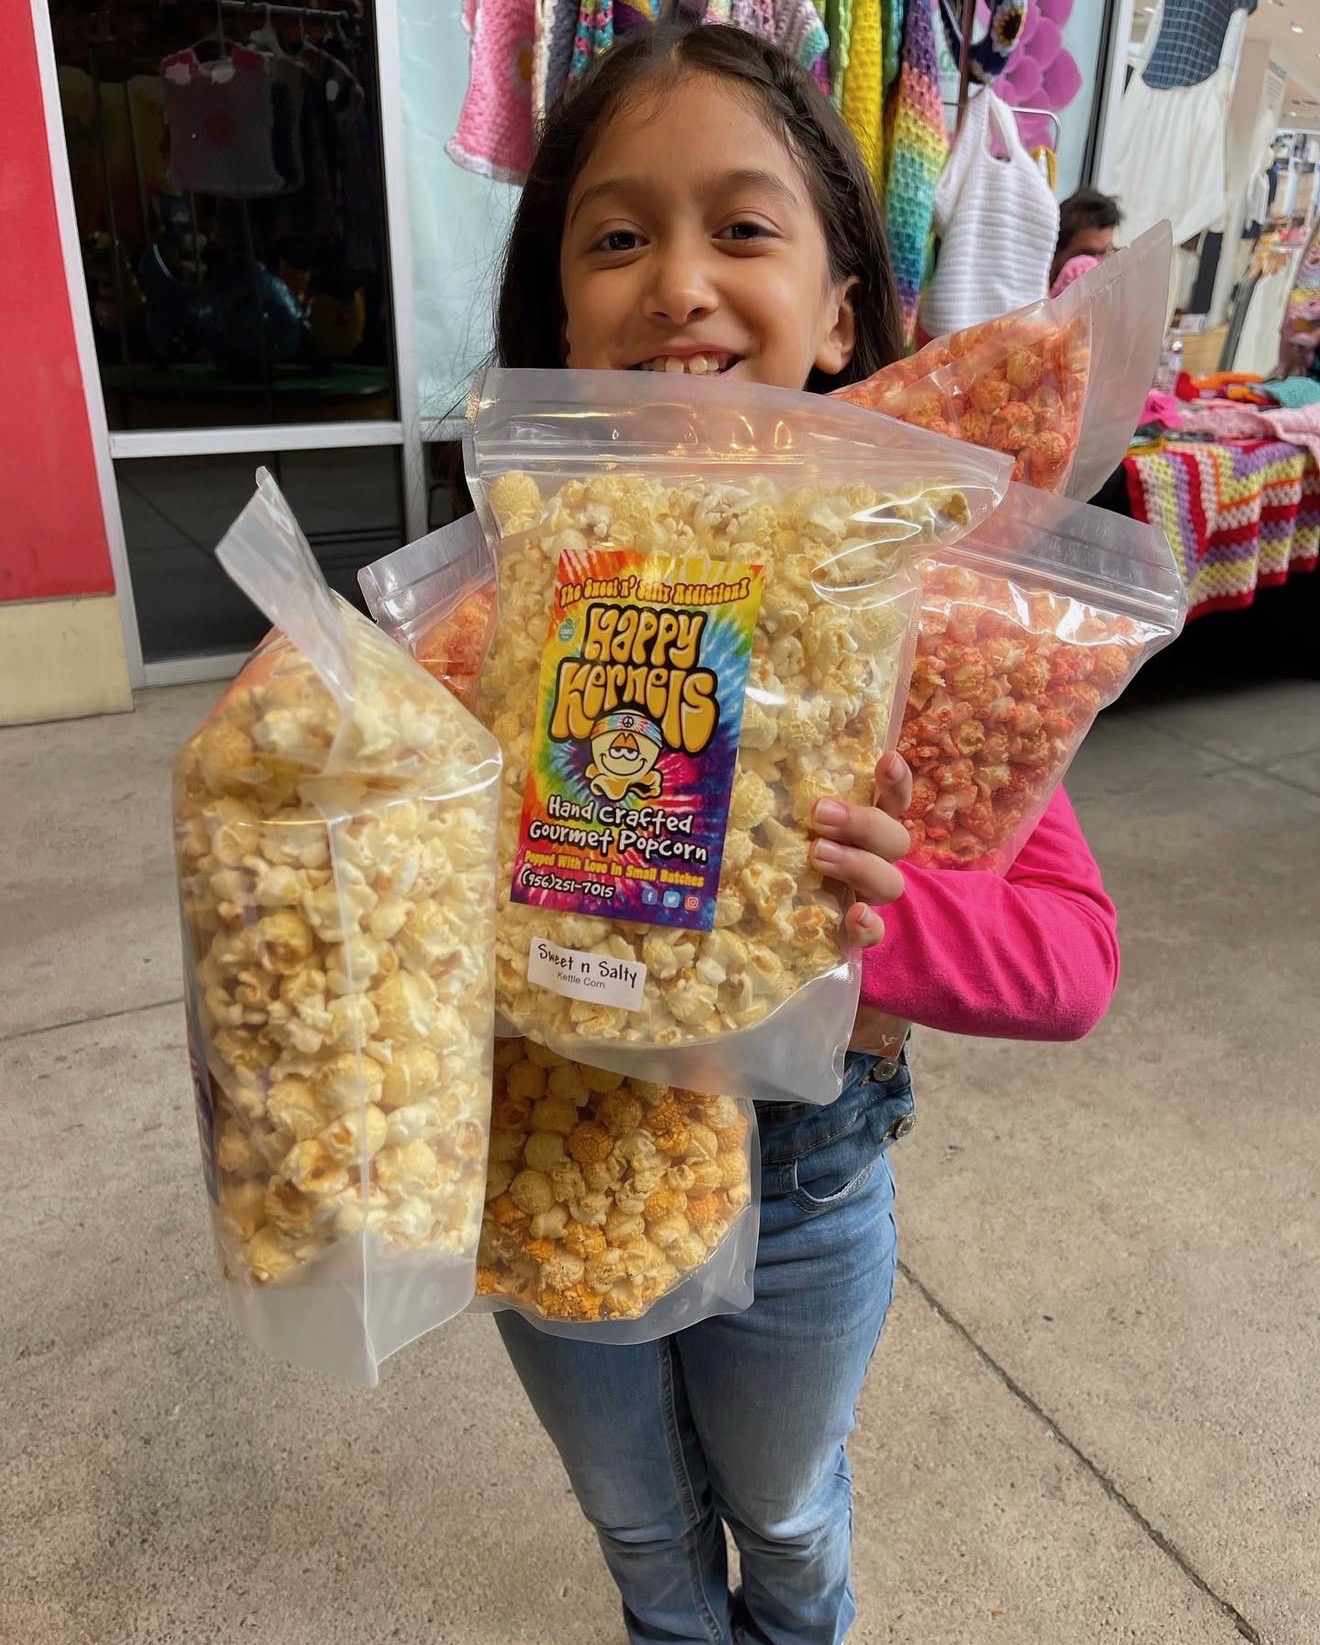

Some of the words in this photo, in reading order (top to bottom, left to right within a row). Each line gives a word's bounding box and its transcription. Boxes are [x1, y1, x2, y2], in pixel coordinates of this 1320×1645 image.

[584, 604, 706, 669] Happy
[549, 658, 719, 752] Kernels
[549, 796, 595, 820] Hand
[529, 821, 613, 853] Gourmet
[619, 830, 708, 862] Popcorn
[520, 869, 615, 898] (956)251-7015
[525, 850, 555, 866] Popped
[558, 857, 581, 870] With
[584, 862, 608, 875] Love
[611, 866, 622, 876] In
[626, 866, 657, 881] Small
[660, 870, 704, 888] Batches
[538, 943, 574, 970] Sweet
[580, 961, 591, 974] n
[598, 960, 638, 988] Salty
[557, 972, 581, 984] Kettle
[583, 977, 606, 989] Corn
